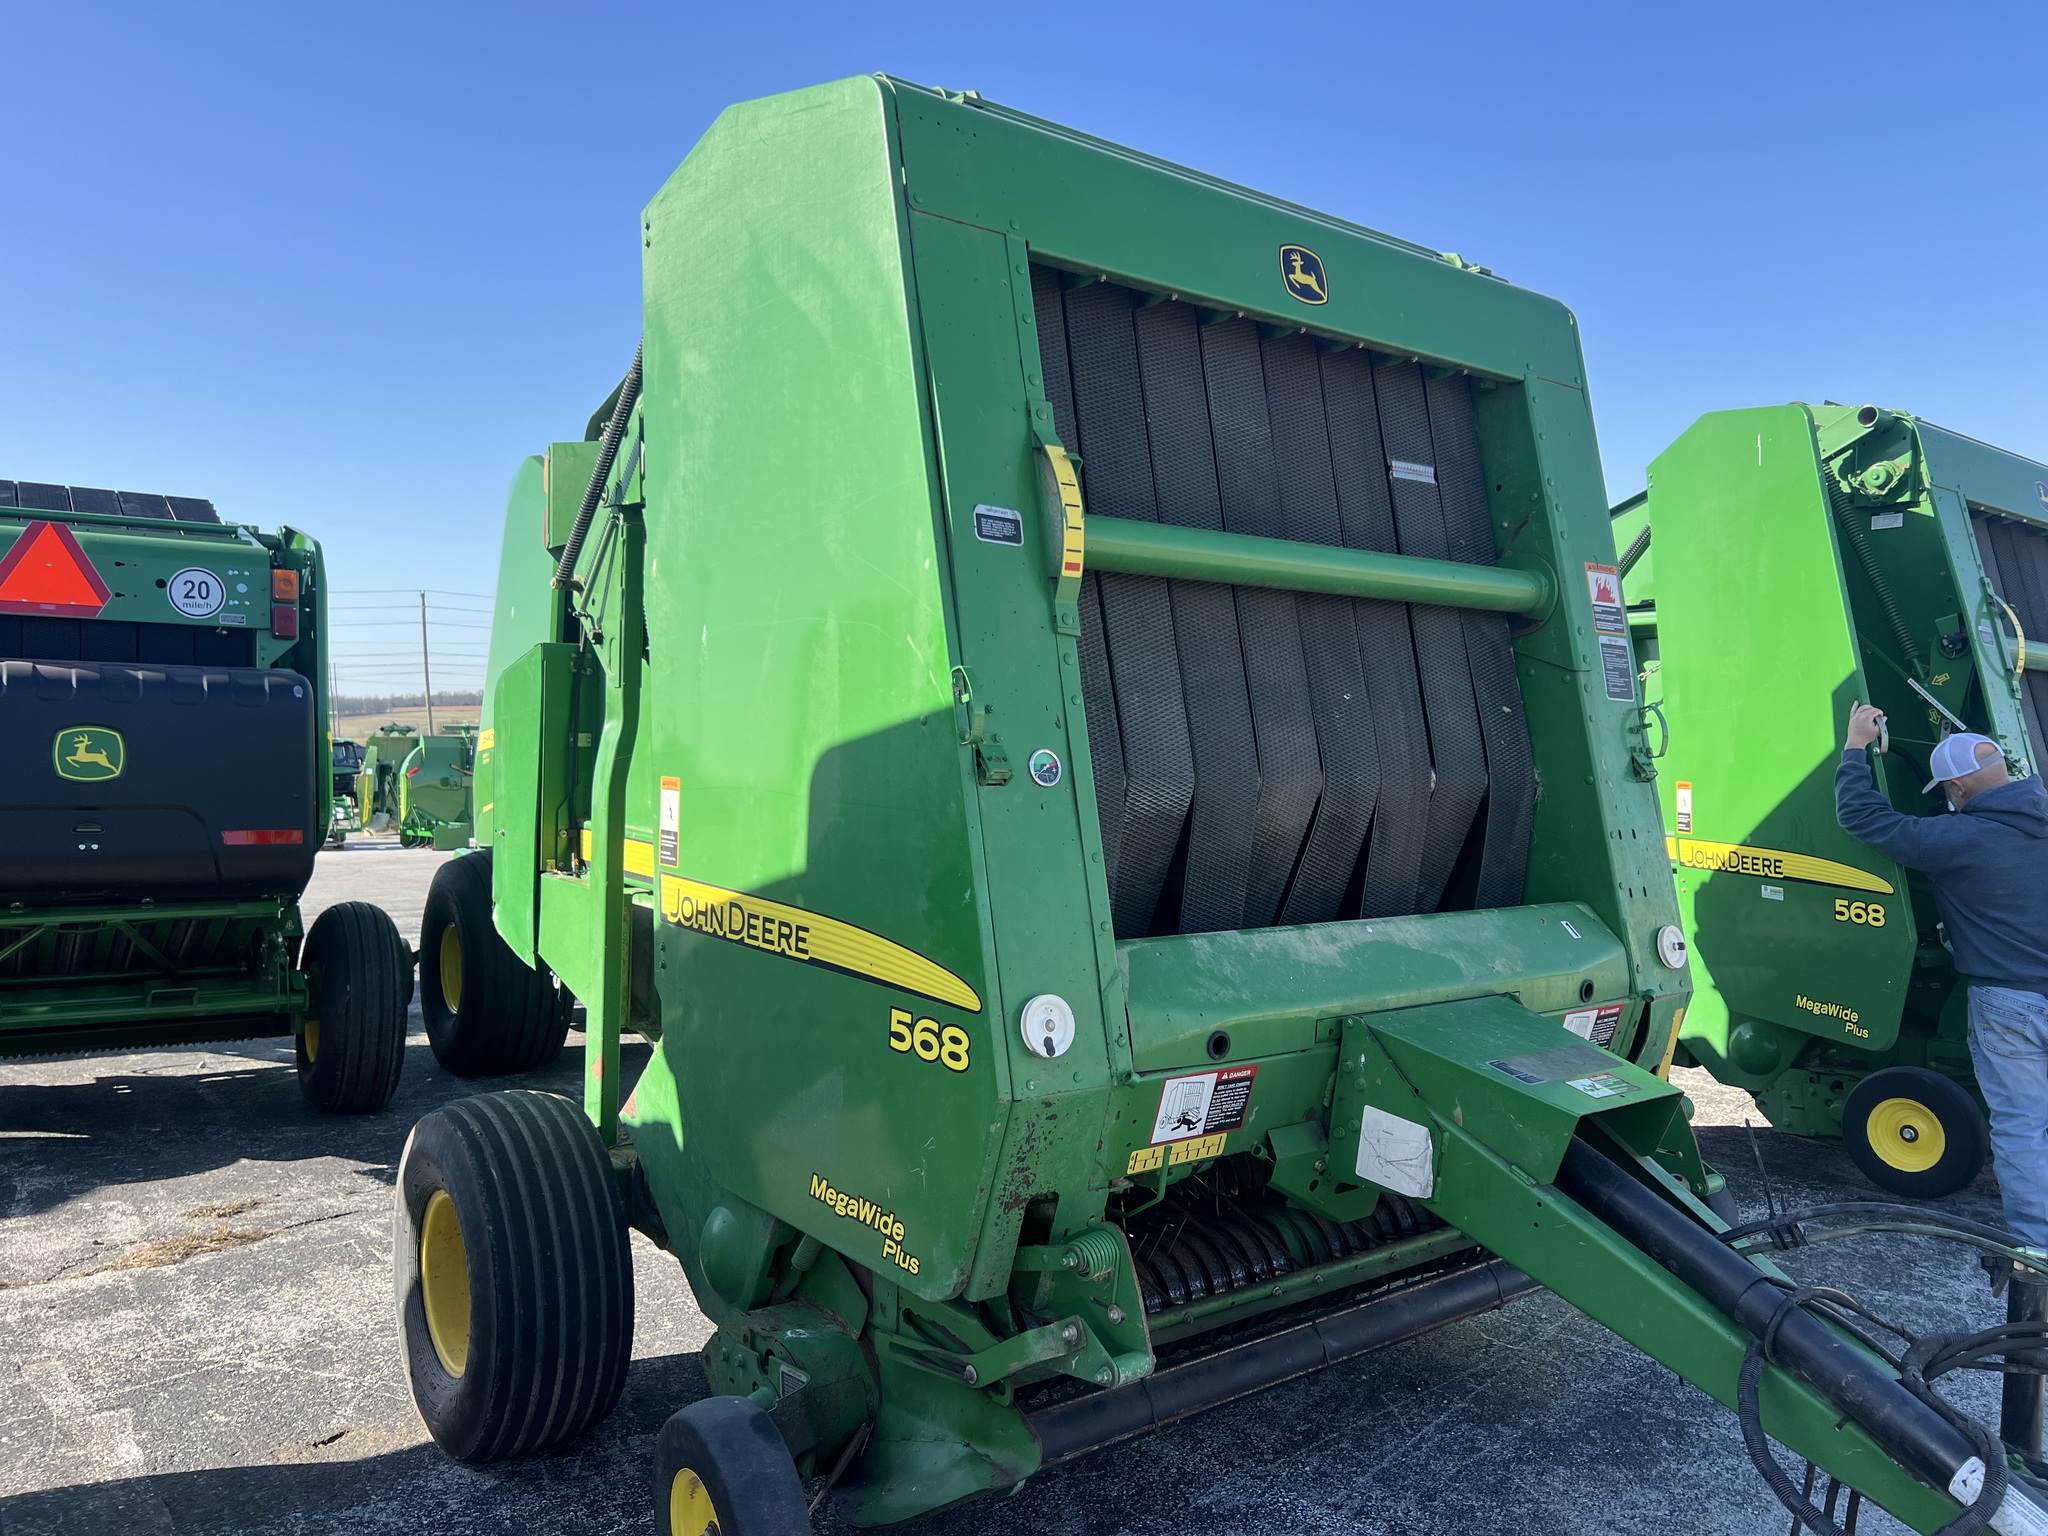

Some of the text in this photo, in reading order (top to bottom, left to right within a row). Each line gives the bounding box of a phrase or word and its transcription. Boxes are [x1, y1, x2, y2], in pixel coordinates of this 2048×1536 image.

[183, 580, 210, 600] 20
[182, 601, 212, 609] mile/h
[1686, 846, 1784, 875] JOHN DEERE
[670, 888, 811, 956] JOHN DEERE
[1834, 898, 1886, 927] 568
[1795, 994, 1859, 1023] MegaWide
[889, 1005, 971, 1073] 568
[1844, 1021, 1869, 1039] Plus
[1228, 1069, 1252, 1079] DANGER
[809, 1172, 905, 1242] MegaWide
[882, 1238, 921, 1276] Plus
